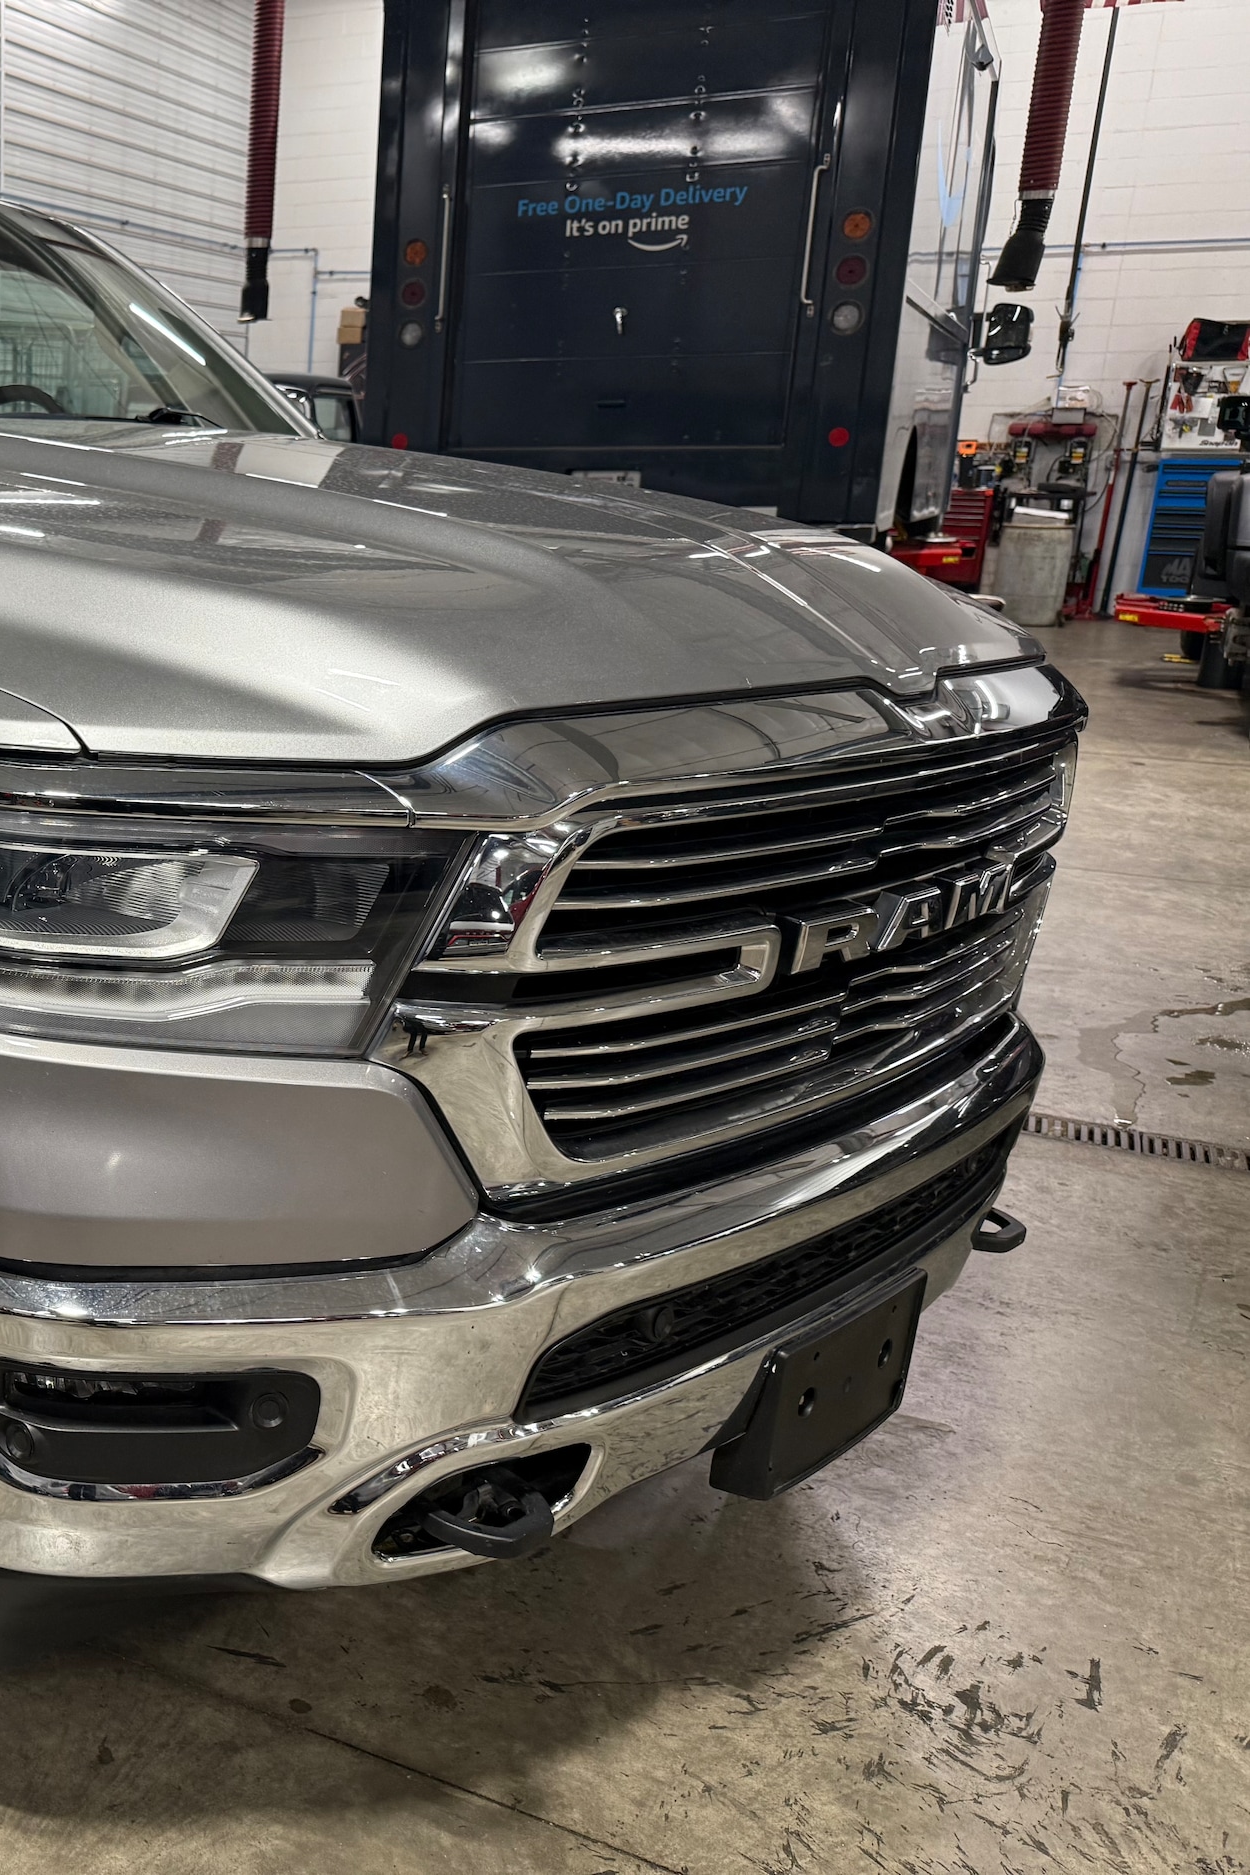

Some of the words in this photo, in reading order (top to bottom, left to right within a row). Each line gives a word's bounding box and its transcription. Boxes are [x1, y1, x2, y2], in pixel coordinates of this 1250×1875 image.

[517, 198, 559, 217] Free
[564, 190, 654, 214] One-Day
[660, 184, 748, 207] Delivery
[565, 218, 594, 237] It's
[597, 218, 623, 235] on
[627, 212, 690, 237] prime
[1161, 557, 1191, 575] MA
[786, 857, 1011, 976] RAM
